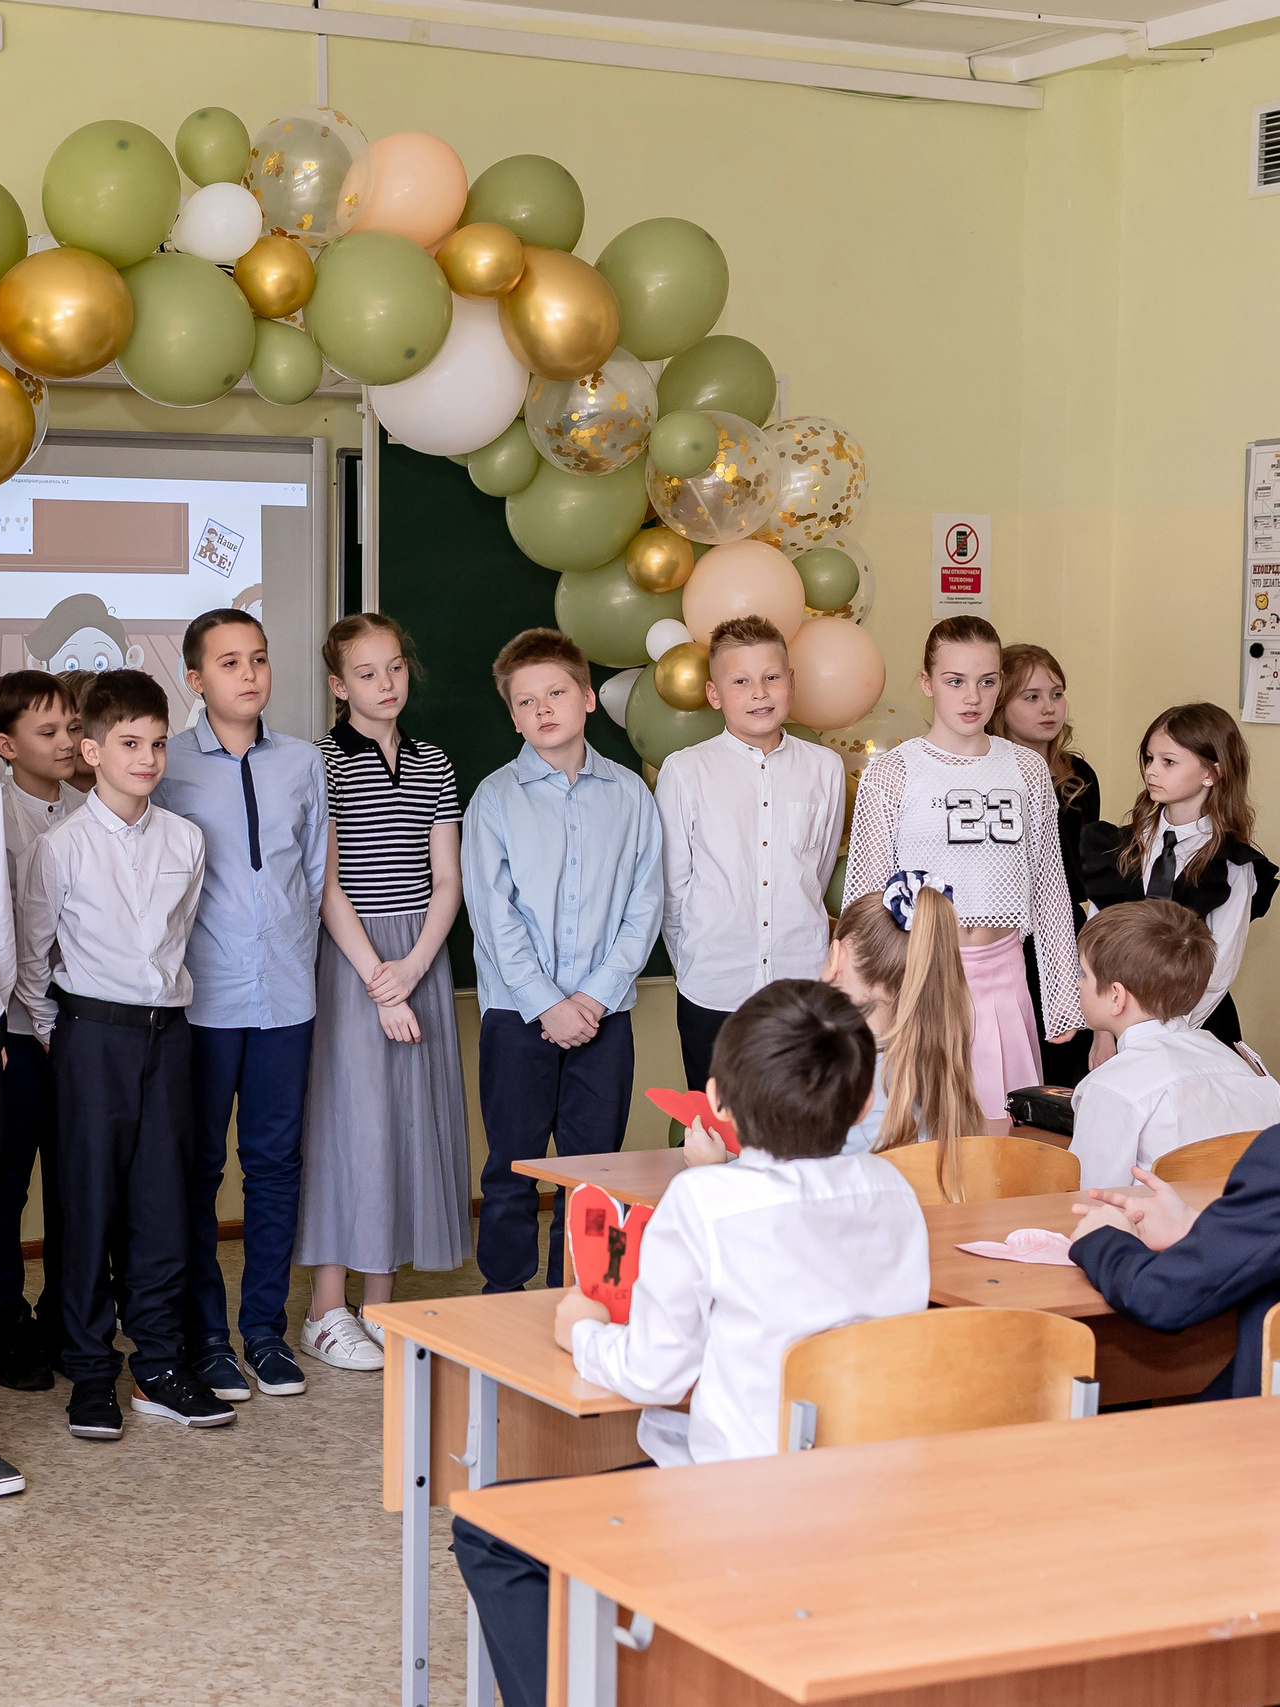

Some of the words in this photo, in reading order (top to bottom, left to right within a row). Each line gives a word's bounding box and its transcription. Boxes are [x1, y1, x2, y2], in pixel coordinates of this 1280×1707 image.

[216, 533, 238, 552] Наше
[197, 545, 232, 572] ВСЁ!
[1252, 578, 1262, 588] ЧТО
[945, 788, 1024, 844] 23
